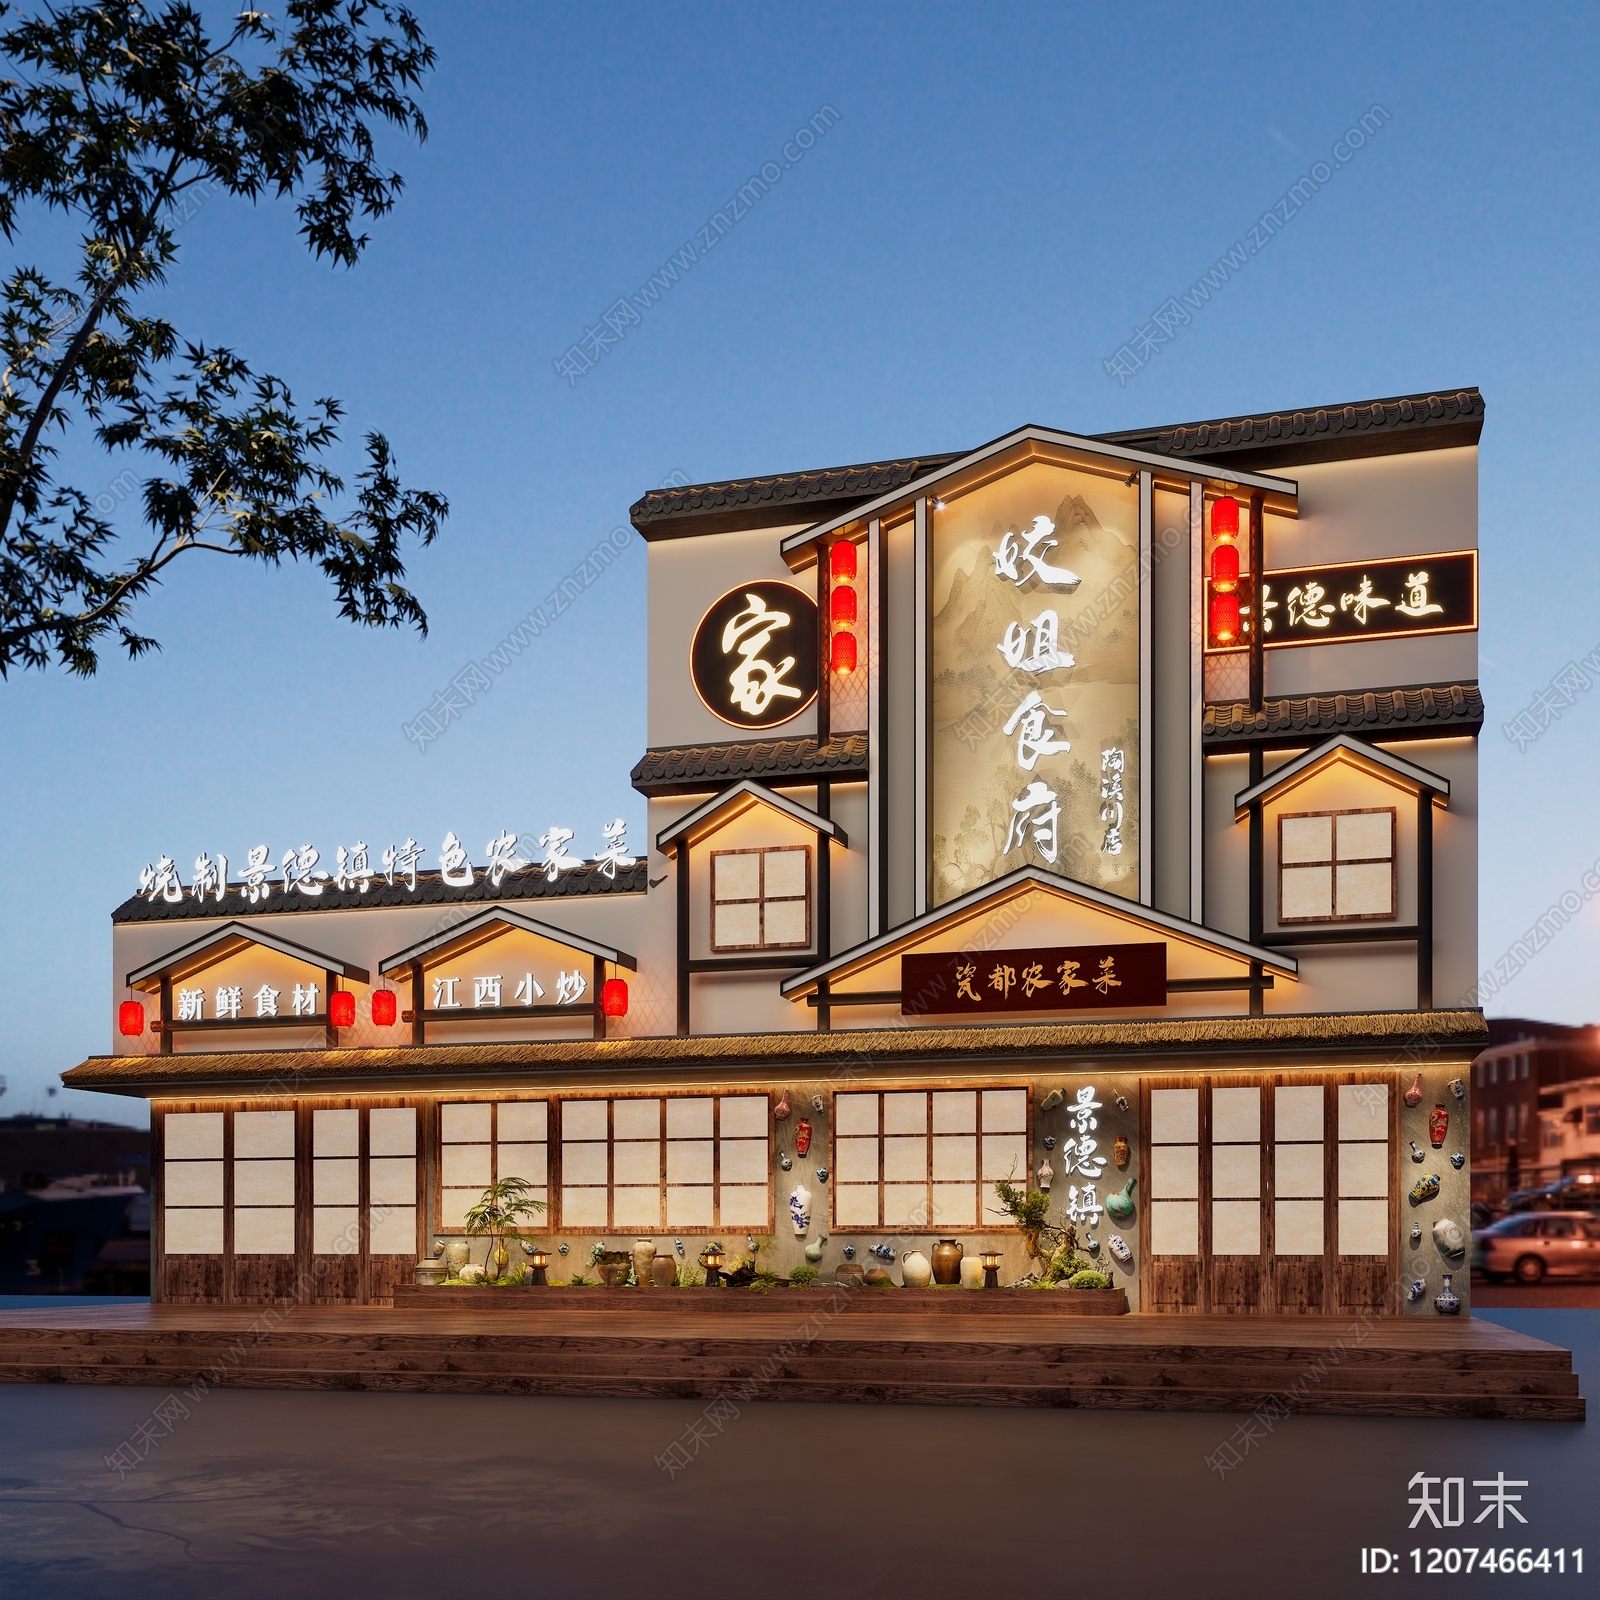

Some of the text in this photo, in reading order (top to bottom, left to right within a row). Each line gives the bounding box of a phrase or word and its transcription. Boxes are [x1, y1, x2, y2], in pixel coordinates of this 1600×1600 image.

[722, 593, 802, 716] 家
[139, 818, 637, 903] 烧制景德镇特色农家菜
[178, 983, 320, 1020] 新鲜食材
[433, 970, 588, 1008] 江西小炒
[956, 956, 1122, 1001] 瓷都农家菜
[1063, 1086, 1107, 1225] 景德镇
